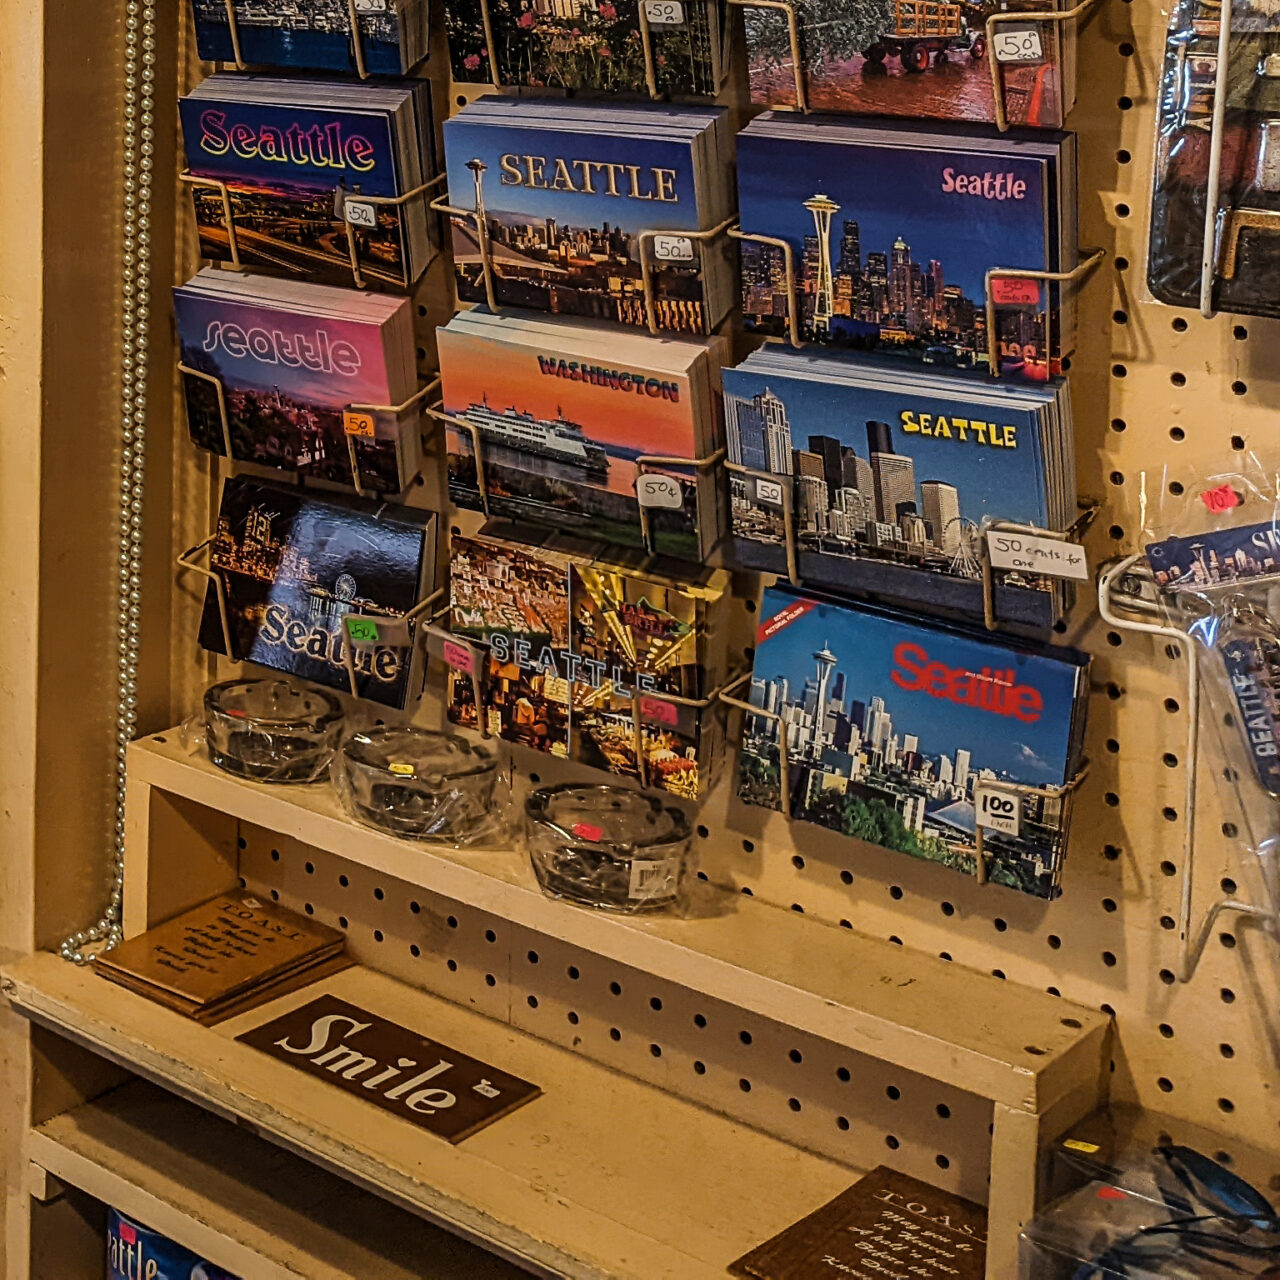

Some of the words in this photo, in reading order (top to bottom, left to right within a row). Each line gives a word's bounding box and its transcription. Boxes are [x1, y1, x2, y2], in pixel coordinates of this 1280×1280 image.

[200, 109, 375, 172] Seattle
[499, 153, 679, 203] SEATTLE
[941, 167, 1027, 200] Seattle
[202, 319, 362, 377] seattle
[537, 355, 680, 403] WASHINGTON
[900, 410, 1018, 449] SEATTLE
[993, 537, 1022, 553] 50
[1026, 547, 1061, 561] cents
[1066, 551, 1082, 567] for
[1012, 558, 1035, 570] one
[490, 632, 656, 698] SEATTLE
[891, 641, 1045, 724] Seattle
[983, 795, 1015, 813] 100
[275, 1013, 458, 1116] Smile
